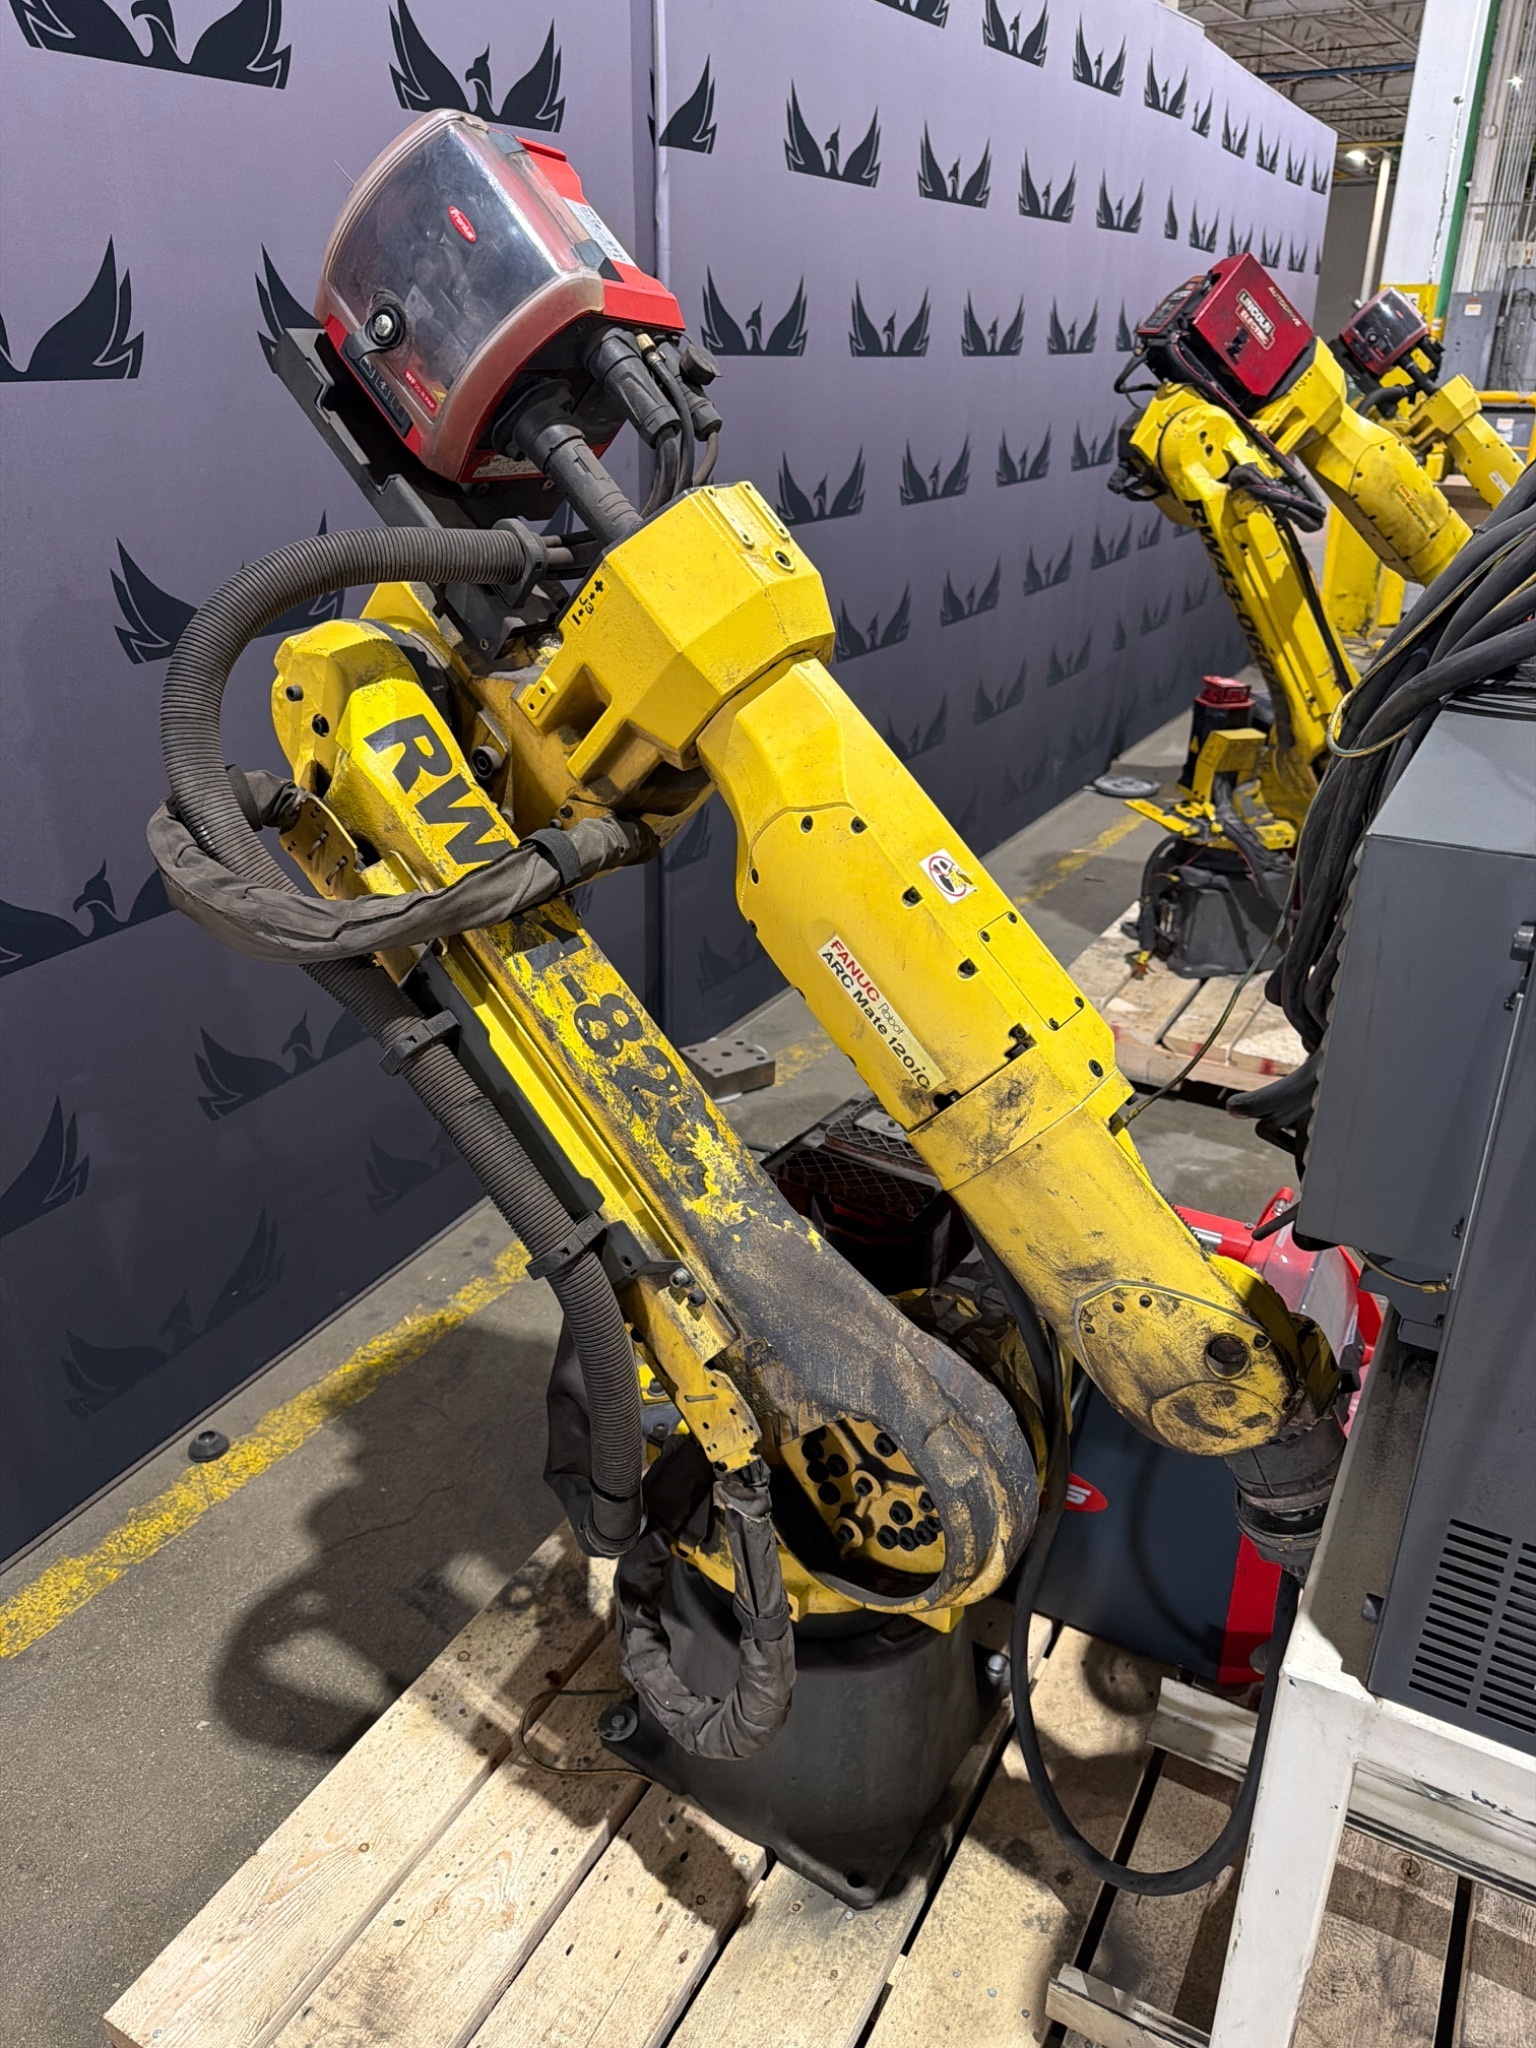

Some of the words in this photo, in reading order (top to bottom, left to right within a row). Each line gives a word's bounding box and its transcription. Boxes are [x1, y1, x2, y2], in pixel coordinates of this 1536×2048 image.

[1239, 292, 1273, 334] LINCOLN
[1240, 309, 1270, 345] ELECTRIC
[822, 952, 854, 989] ARC
[853, 990, 888, 1035] Mate
[888, 1037, 930, 1090] 120iC
[831, 940, 880, 1002] FANUC
[878, 1003, 904, 1034] Robot
